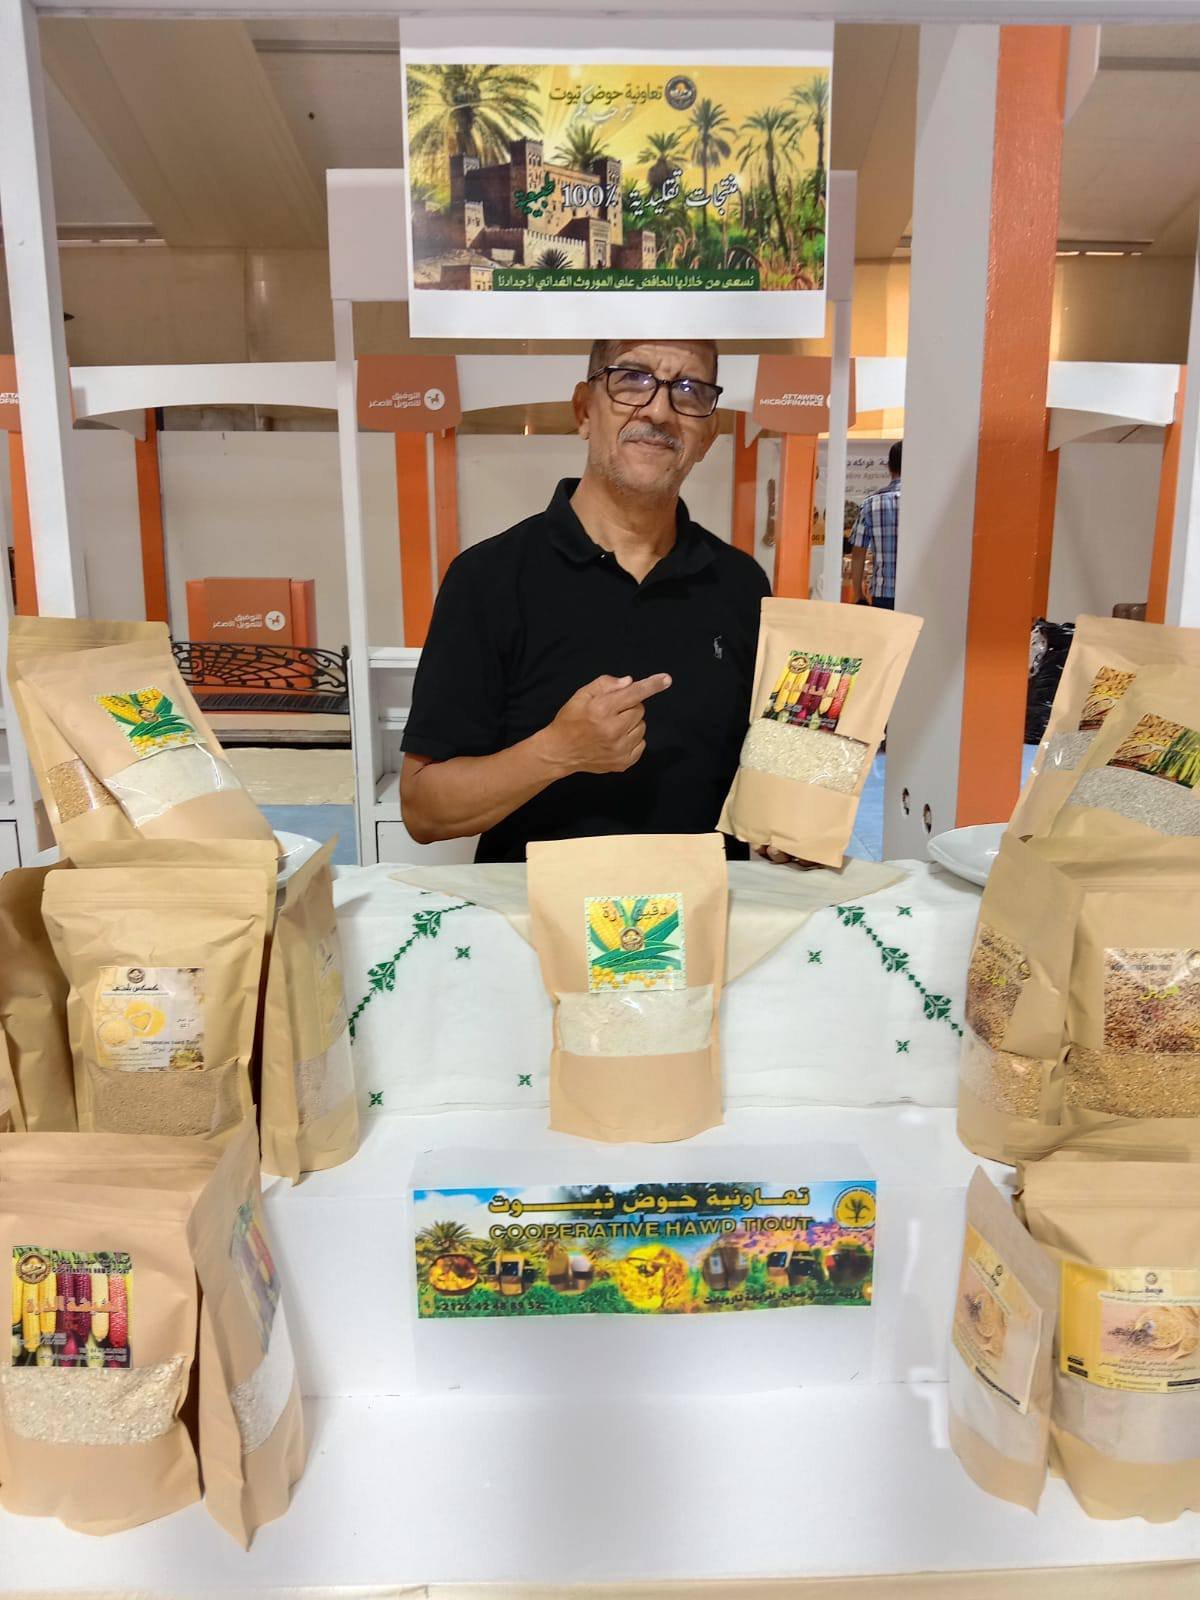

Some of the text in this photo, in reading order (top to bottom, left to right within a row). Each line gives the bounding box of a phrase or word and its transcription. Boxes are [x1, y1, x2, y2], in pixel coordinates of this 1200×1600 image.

[548, 84, 581, 106] تيوت
[582, 86, 624, 105] حوض
[625, 83, 663, 105] تعاونية
[628, 167, 683, 216] تقليدية
[685, 172, 740, 216] منتجات
[573, 275, 613, 290] الموروث
[614, 275, 635, 290] على
[675, 275, 703, 289] خلالها
[705, 279, 721, 290] من
[722, 276, 755, 289] نسعى
[759, 398, 825, 407] MICROFINANCE
[488, 1191, 615, 1217] تيوت
[622, 1191, 699, 1214] حوض
[705, 1186, 810, 1213] تعاونية
[489, 1215, 814, 1241] COOPERATIVE HAWD TIOUT
